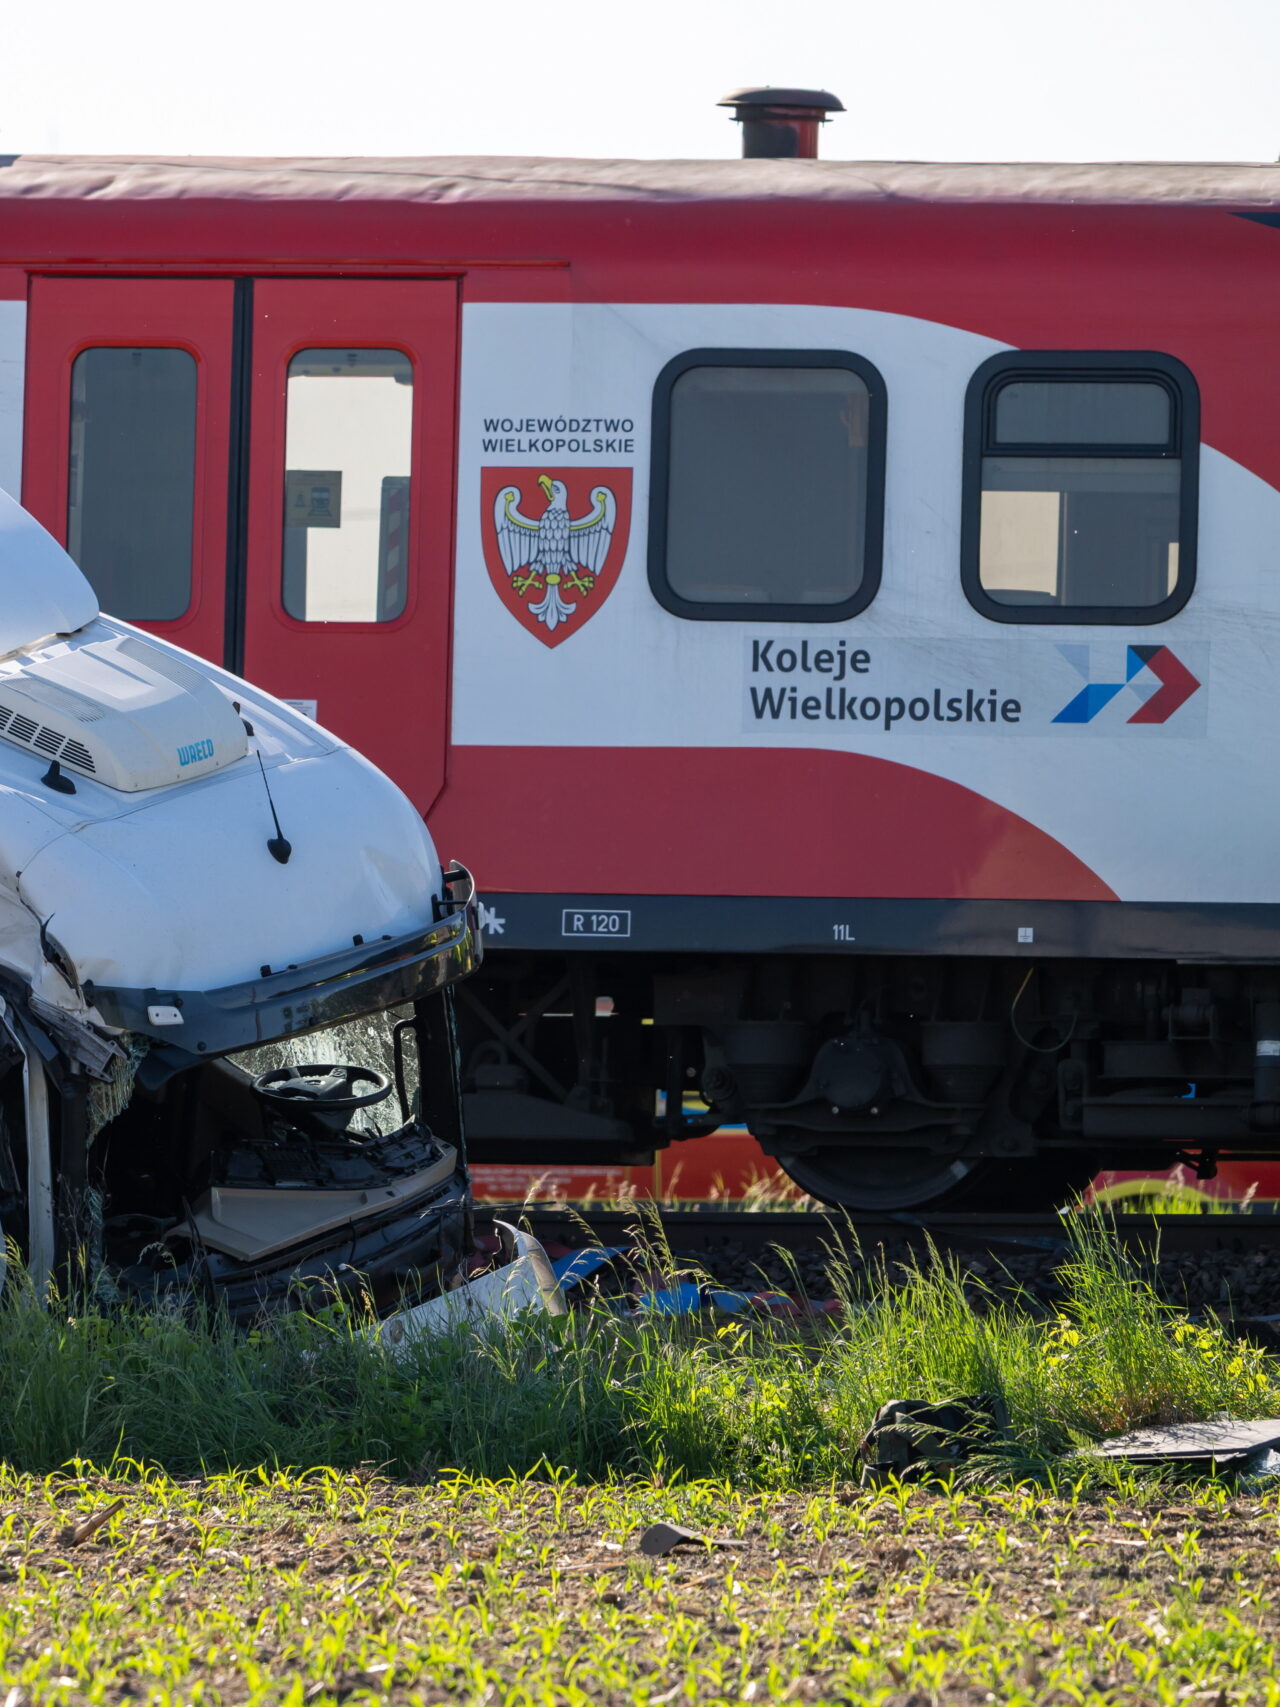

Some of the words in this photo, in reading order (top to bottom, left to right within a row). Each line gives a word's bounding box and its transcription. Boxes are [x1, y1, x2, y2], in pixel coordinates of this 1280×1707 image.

[483, 415, 634, 433] WOJEWÓDZTWO
[482, 438, 635, 453] WIELKOPOLSKIE
[751, 640, 871, 681] Koleje
[749, 686, 1022, 731] Wielkopolskie
[573, 914, 585, 931] R
[591, 915, 620, 932] 120
